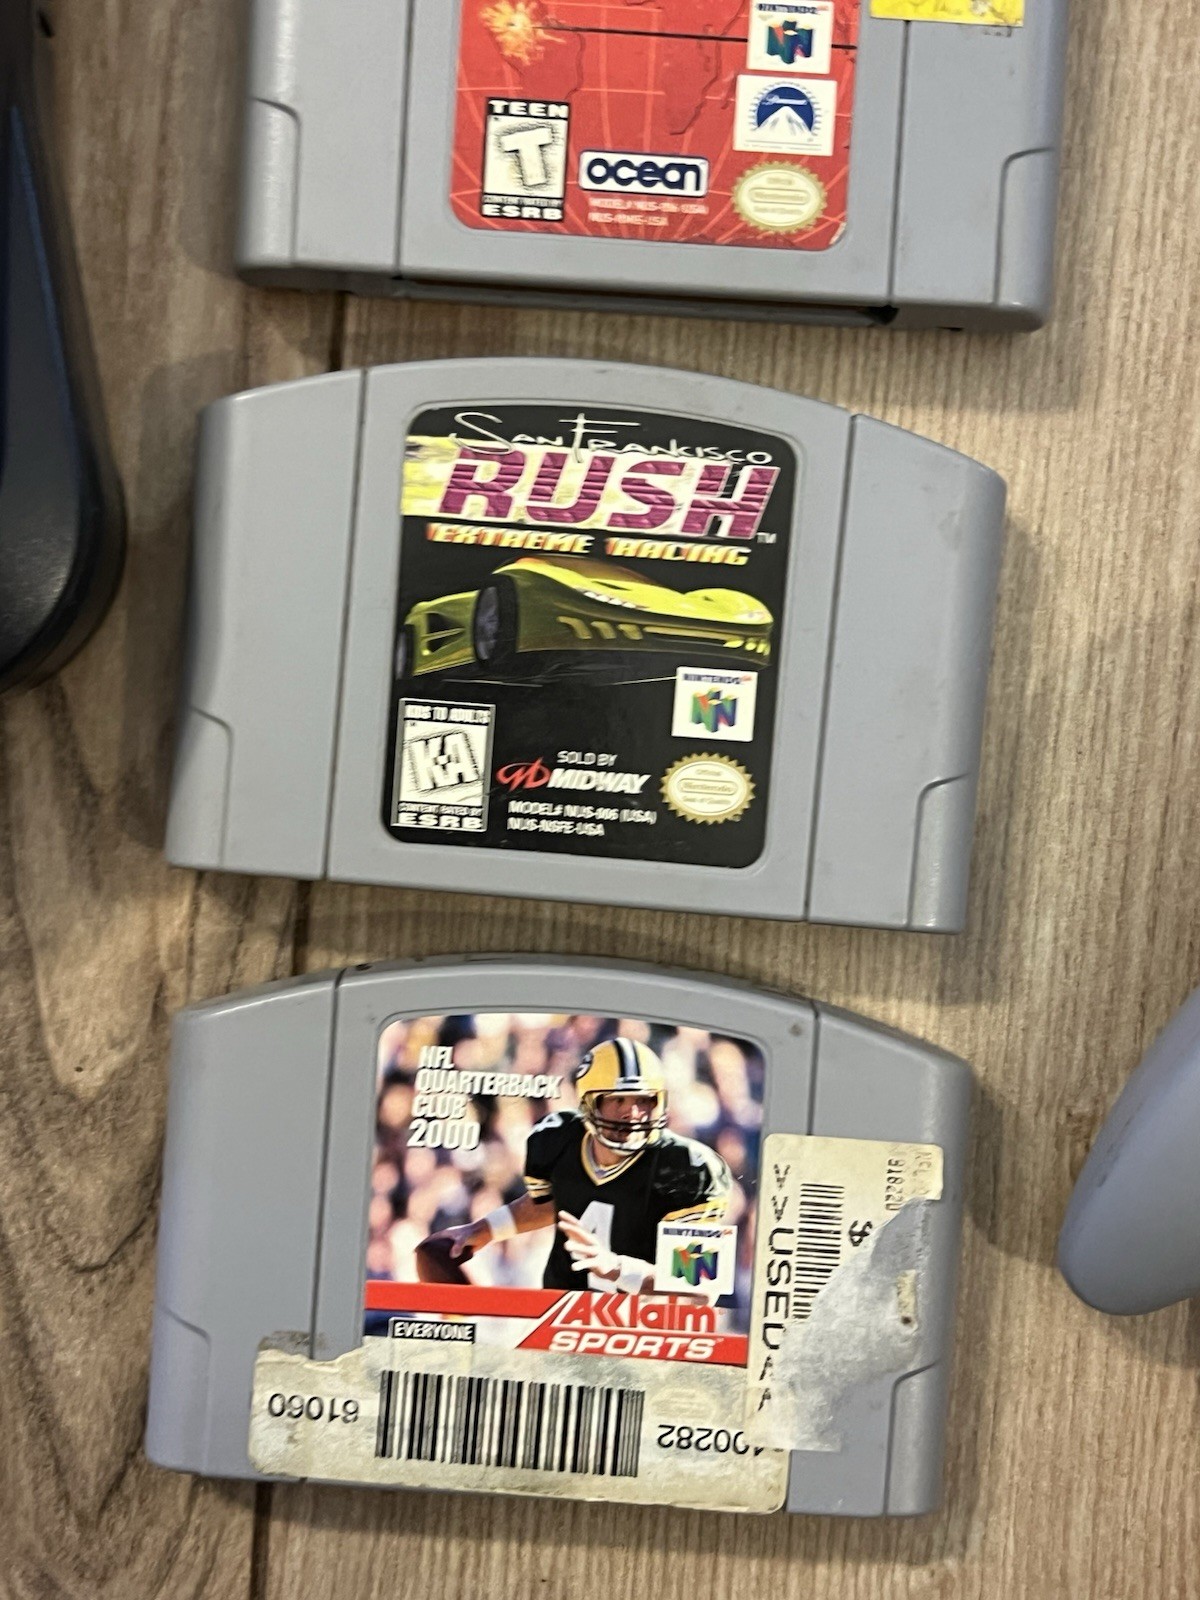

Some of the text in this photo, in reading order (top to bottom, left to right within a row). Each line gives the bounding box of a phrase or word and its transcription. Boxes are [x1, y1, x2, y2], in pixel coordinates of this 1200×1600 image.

[488, 100, 569, 118] TEEN
[500, 127, 554, 187] T
[587, 158, 700, 191] ocean
[481, 204, 563, 220] ESRB
[438, 446, 781, 540] RUSH
[426, 522, 752, 566] EXTREME RACING
[557, 750, 618, 767] SOLD BY
[546, 767, 652, 794] MIDWAY
[399, 812, 483, 829] ESRB
[418, 1045, 455, 1070] NFL
[415, 1069, 564, 1100] QUARTERBACK
[412, 1094, 468, 1119] CLUB
[406, 1118, 482, 1150] 2000
[848, 1219, 873, 1248] $
[394, 1321, 474, 1340] EVERYONE
[550, 1331, 717, 1360] SPORTS
